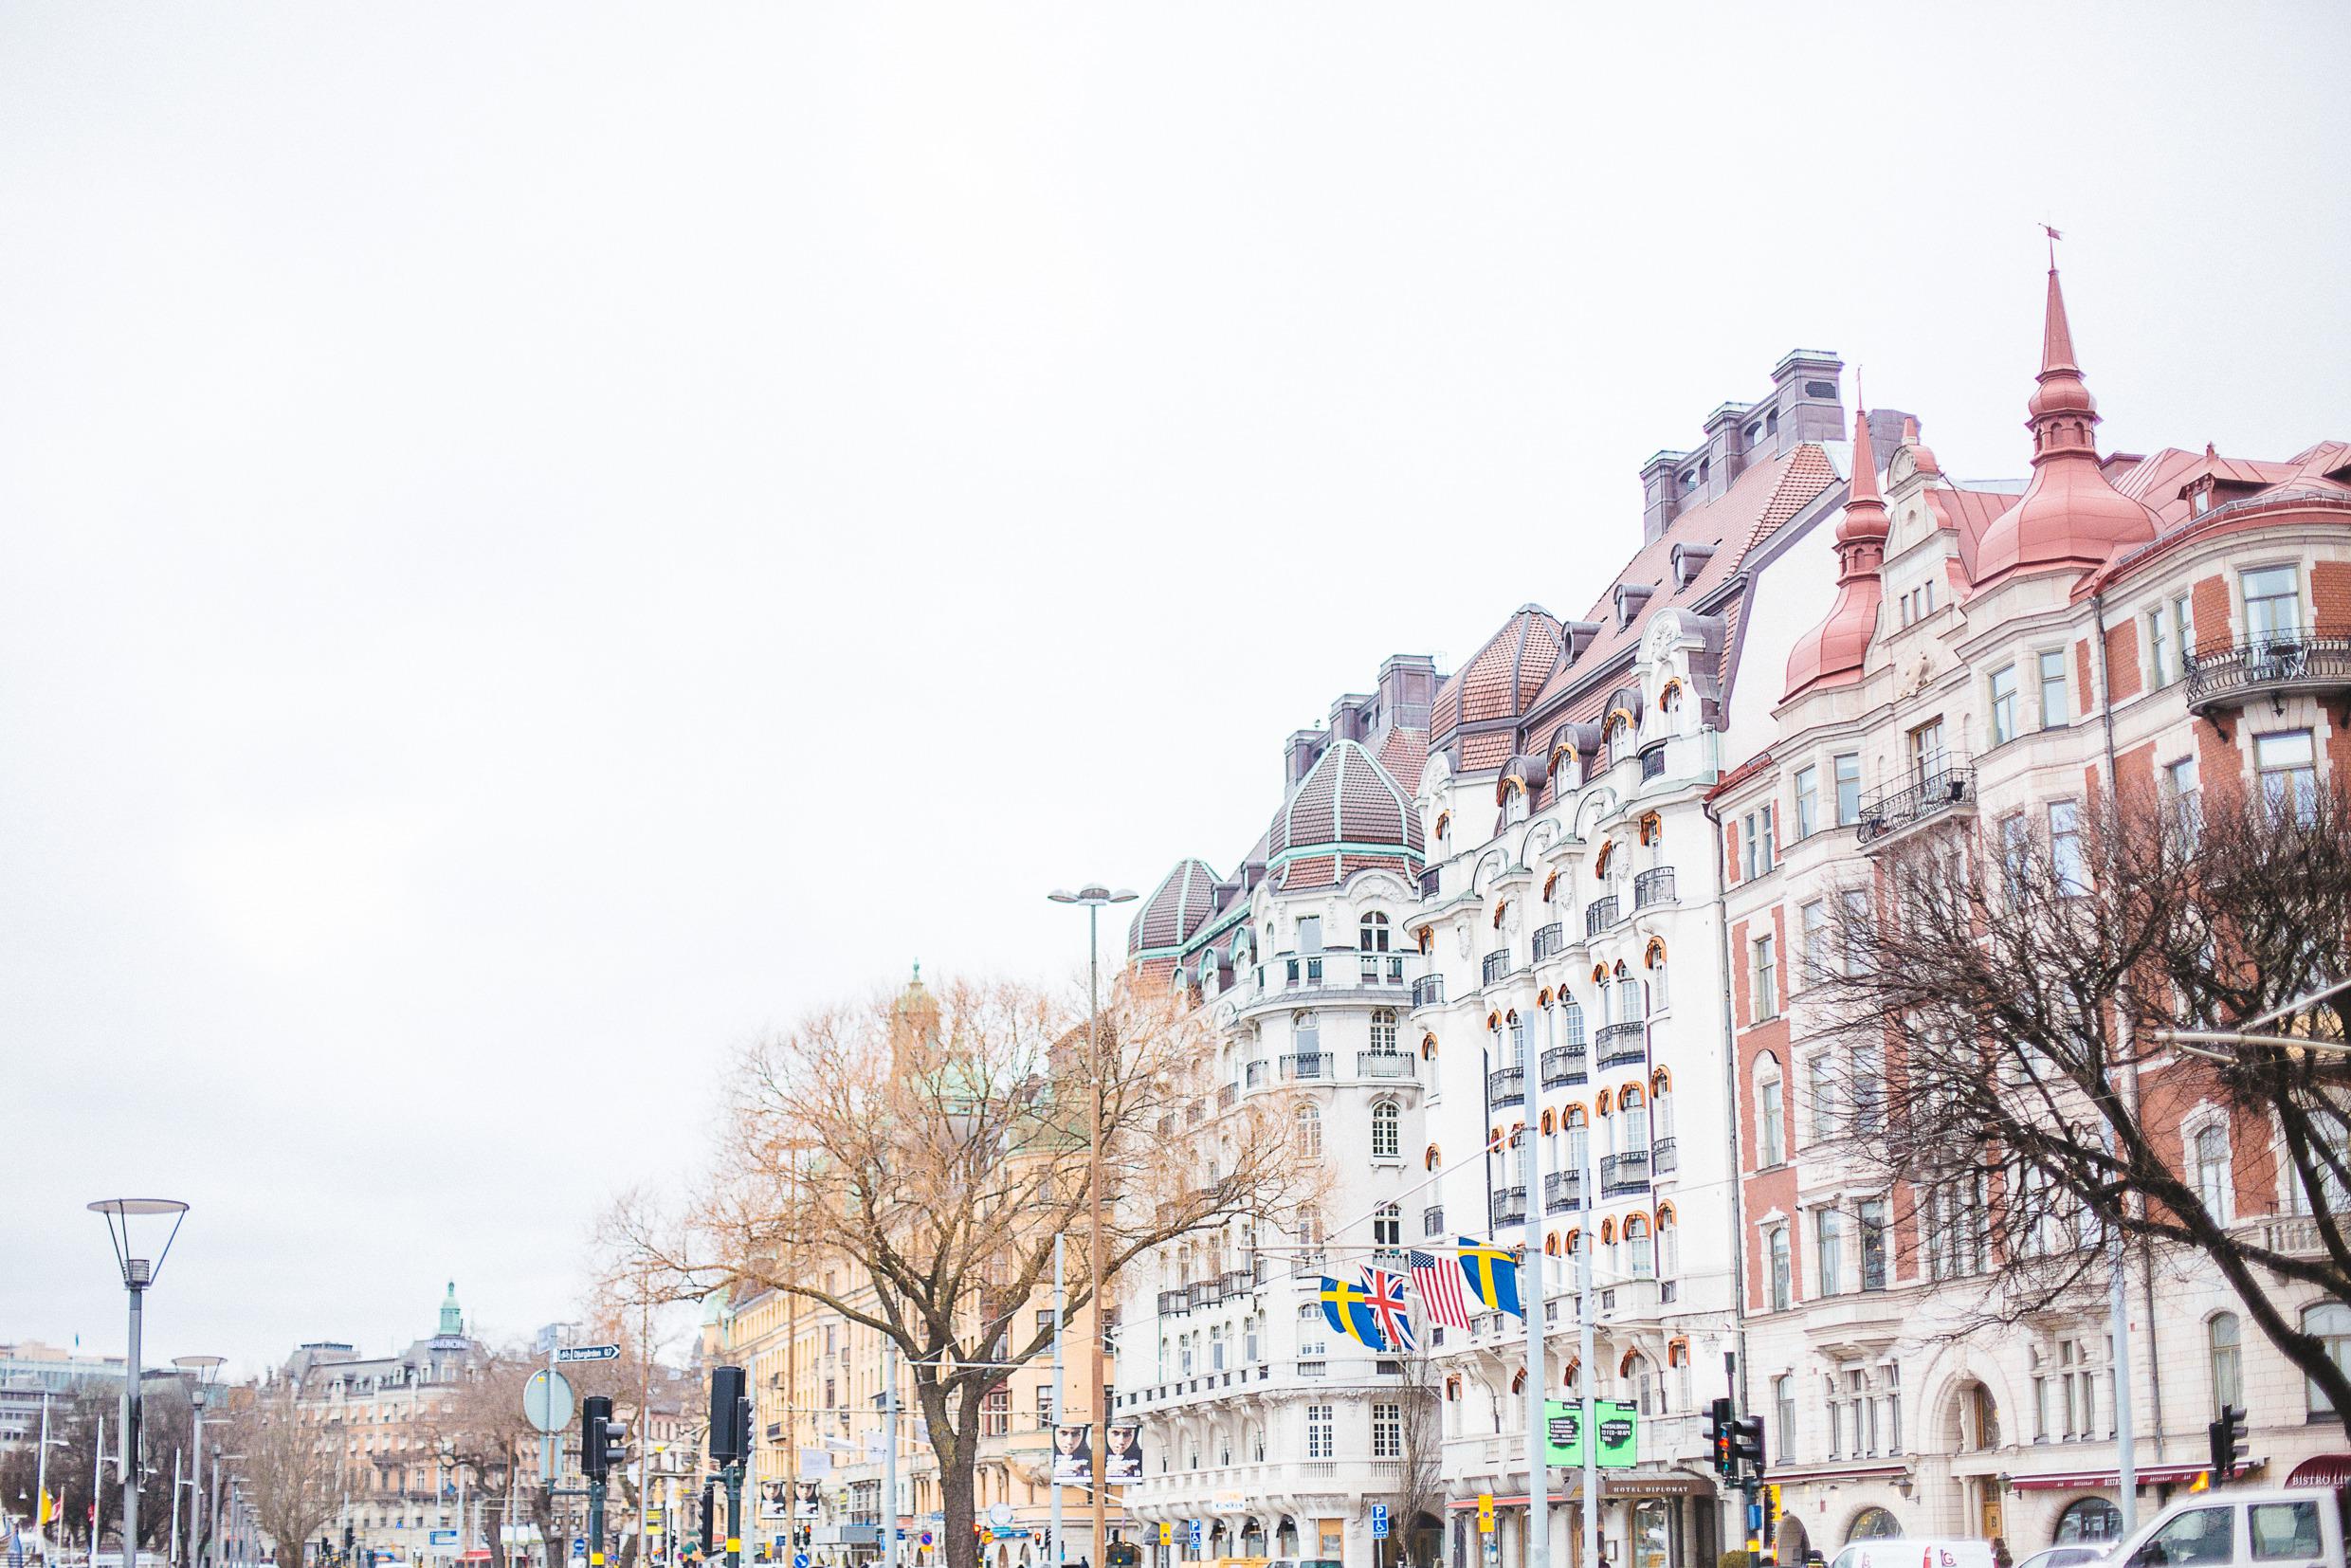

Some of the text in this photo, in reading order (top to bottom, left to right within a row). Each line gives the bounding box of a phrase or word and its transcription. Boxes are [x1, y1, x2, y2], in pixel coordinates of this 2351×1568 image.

[2292, 1474, 2330, 1486] BISTRO
[1376, 1506, 1384, 1519] P
[1192, 1521, 1198, 1531] P
